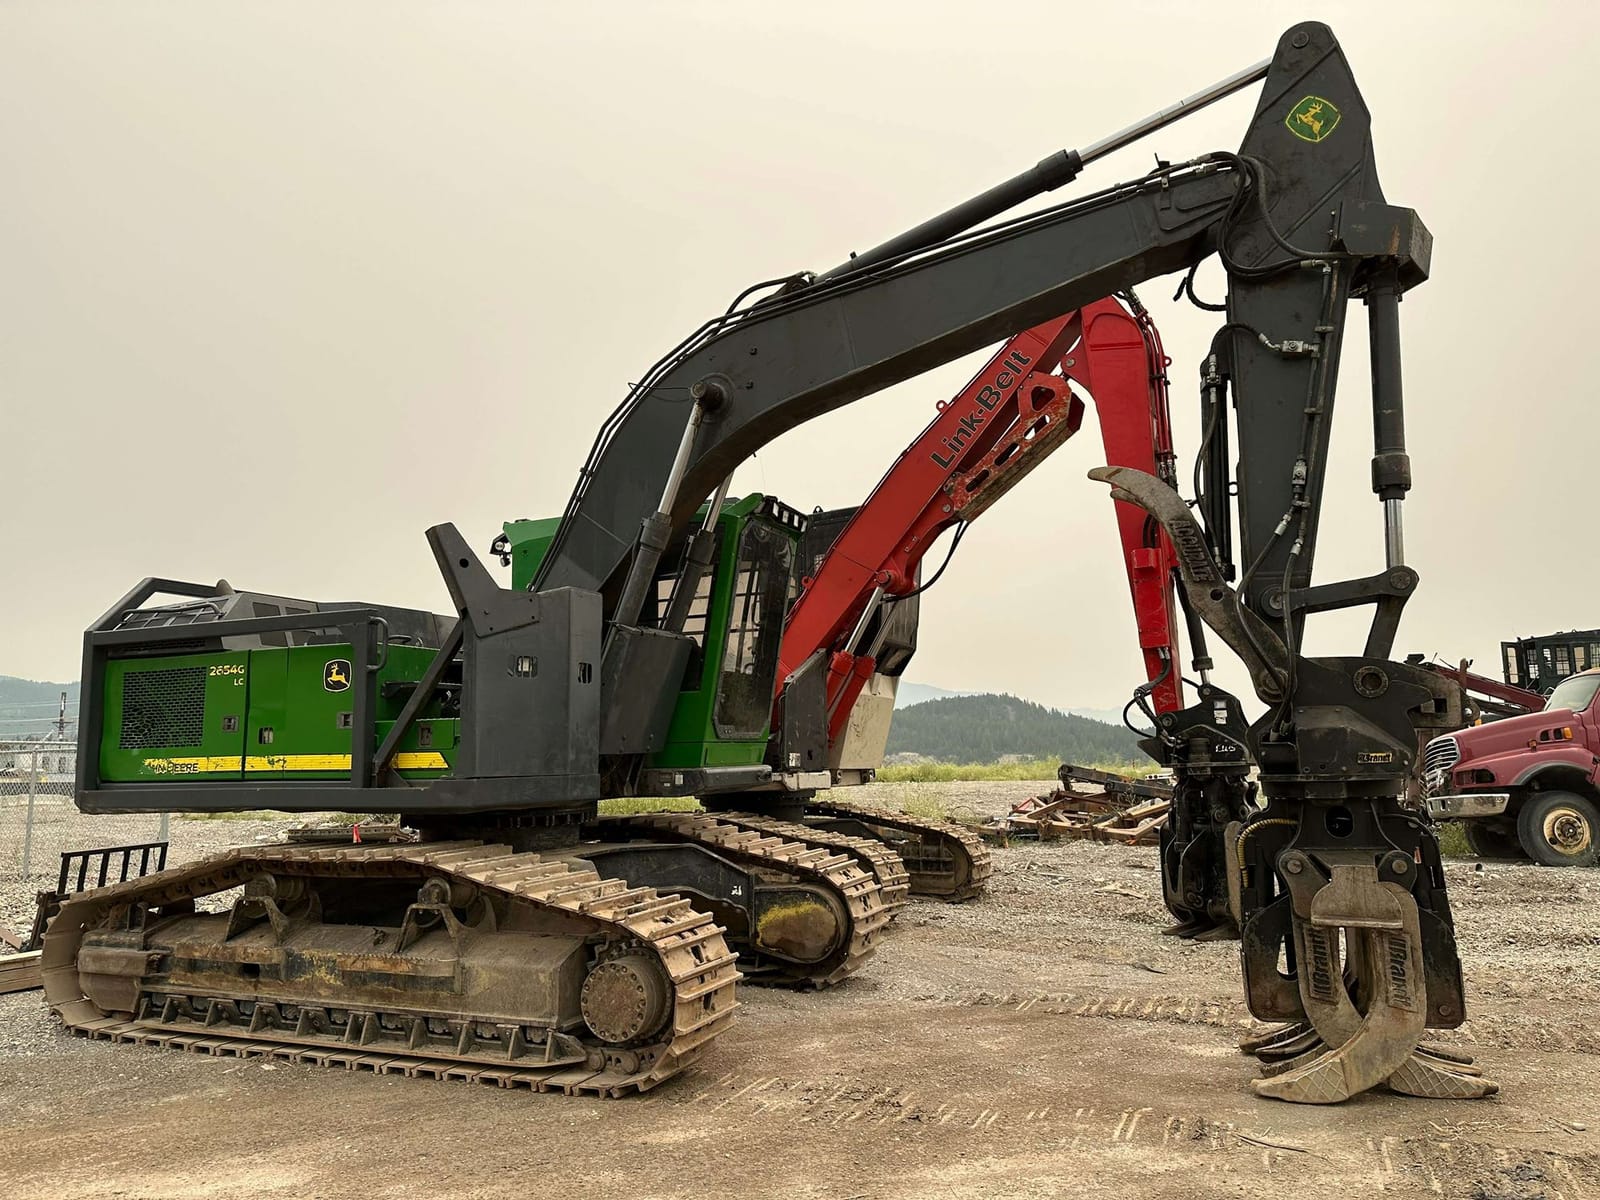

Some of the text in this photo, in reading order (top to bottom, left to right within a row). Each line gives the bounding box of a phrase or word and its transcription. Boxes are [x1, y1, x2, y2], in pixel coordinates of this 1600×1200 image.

[929, 350, 1032, 470] Link-Belt
[209, 664, 245, 676] 2654G
[233, 678, 244, 686] LC
